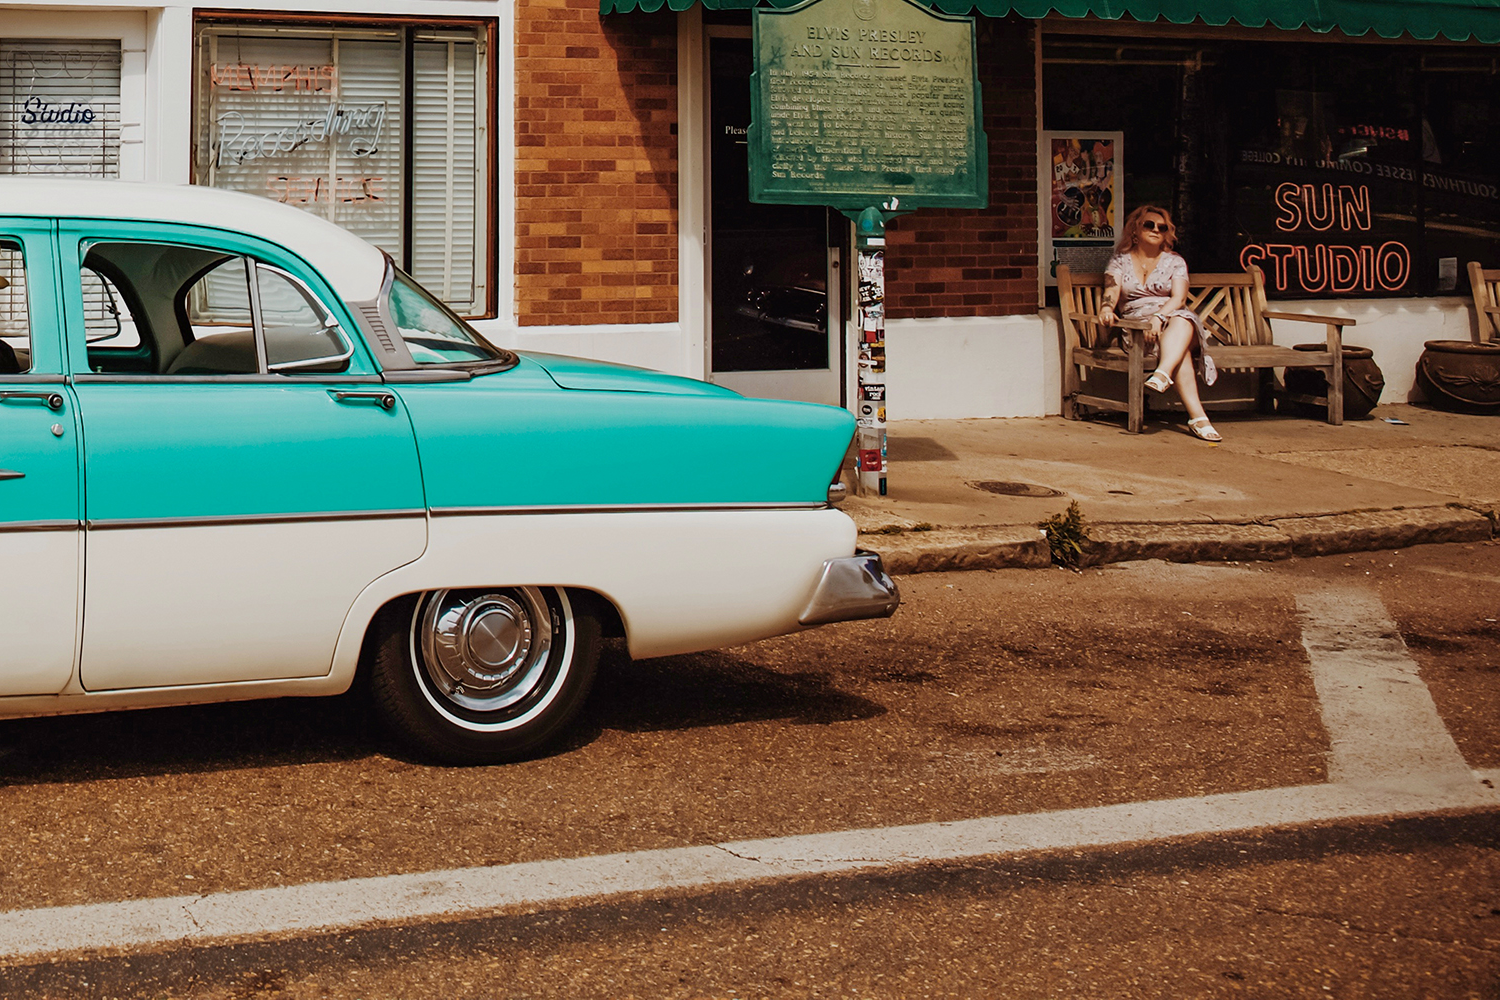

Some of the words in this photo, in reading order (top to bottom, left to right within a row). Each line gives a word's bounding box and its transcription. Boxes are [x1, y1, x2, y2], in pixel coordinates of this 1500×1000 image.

[806, 26, 850, 42] ELVIS
[858, 28, 927, 45] PRESLEY
[790, 43, 823, 59] AND
[831, 45, 862, 60] SUN
[869, 47, 943, 63] RECORDS
[210, 63, 338, 93] MEMPHIS
[21, 96, 96, 124] Studio
[215, 101, 388, 169] Recording
[1275, 182, 1372, 232] SUN
[1240, 241, 1411, 292] STUDIO
